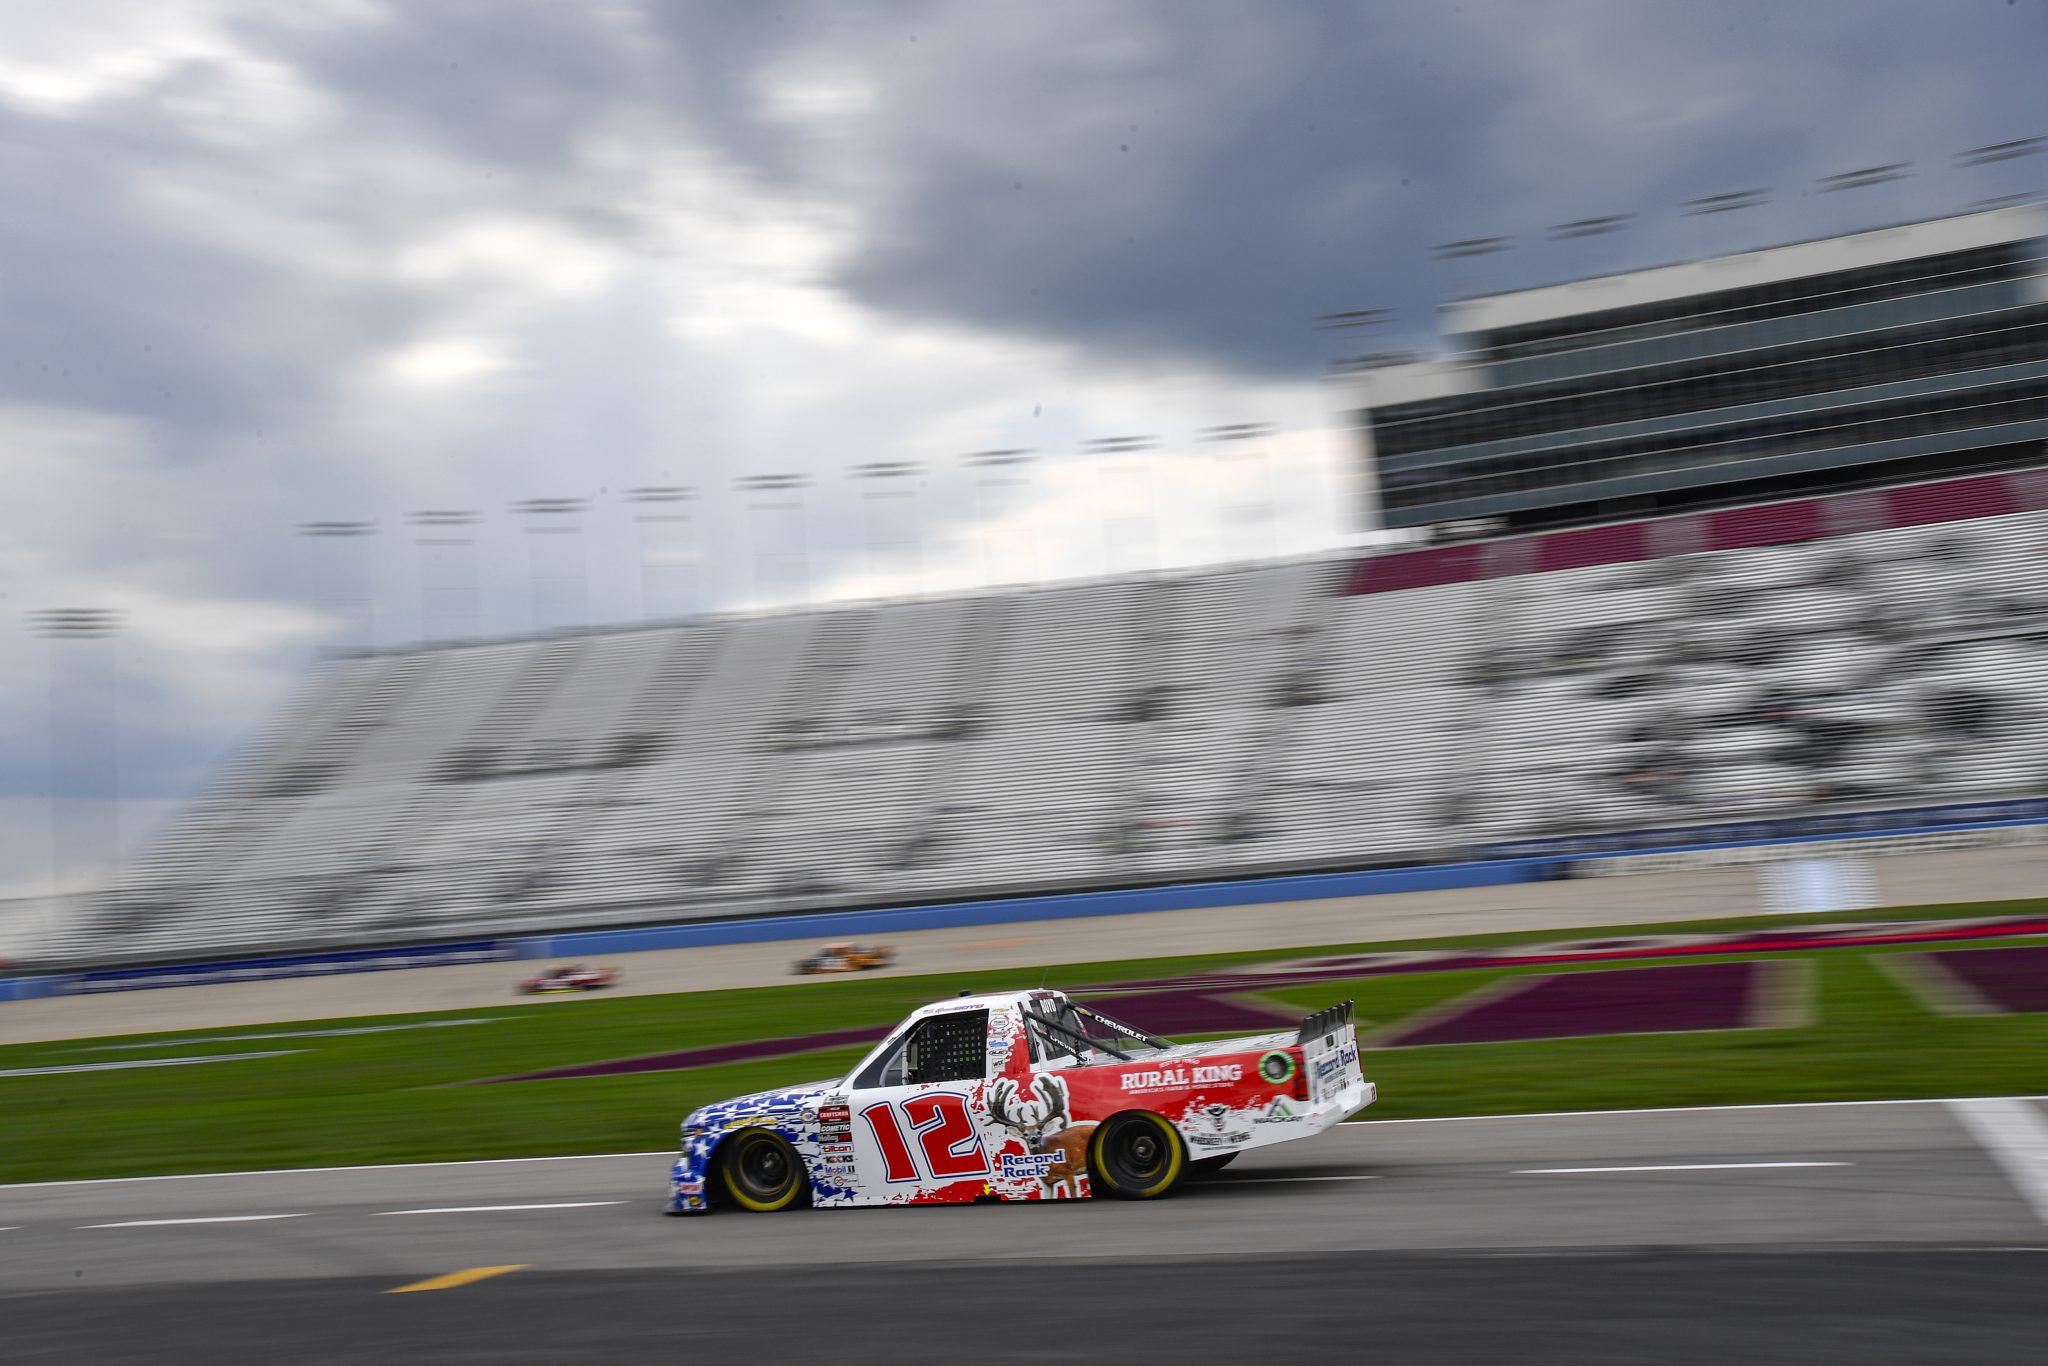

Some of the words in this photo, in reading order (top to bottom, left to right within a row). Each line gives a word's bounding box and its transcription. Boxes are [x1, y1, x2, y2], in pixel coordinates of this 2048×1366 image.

[1040, 999, 1057, 1013] BOYD
[1095, 1015, 1149, 1042] CHEVROLET
[1120, 1069, 1190, 1090] RURAL
[1192, 1064, 1243, 1084] KING
[821, 1124, 850, 1132] COMETIC
[859, 1091, 991, 1183] 12
[1003, 1151, 1065, 1167] Record
[825, 1165, 847, 1174] Mobil
[1004, 1162, 1045, 1178] Rack
